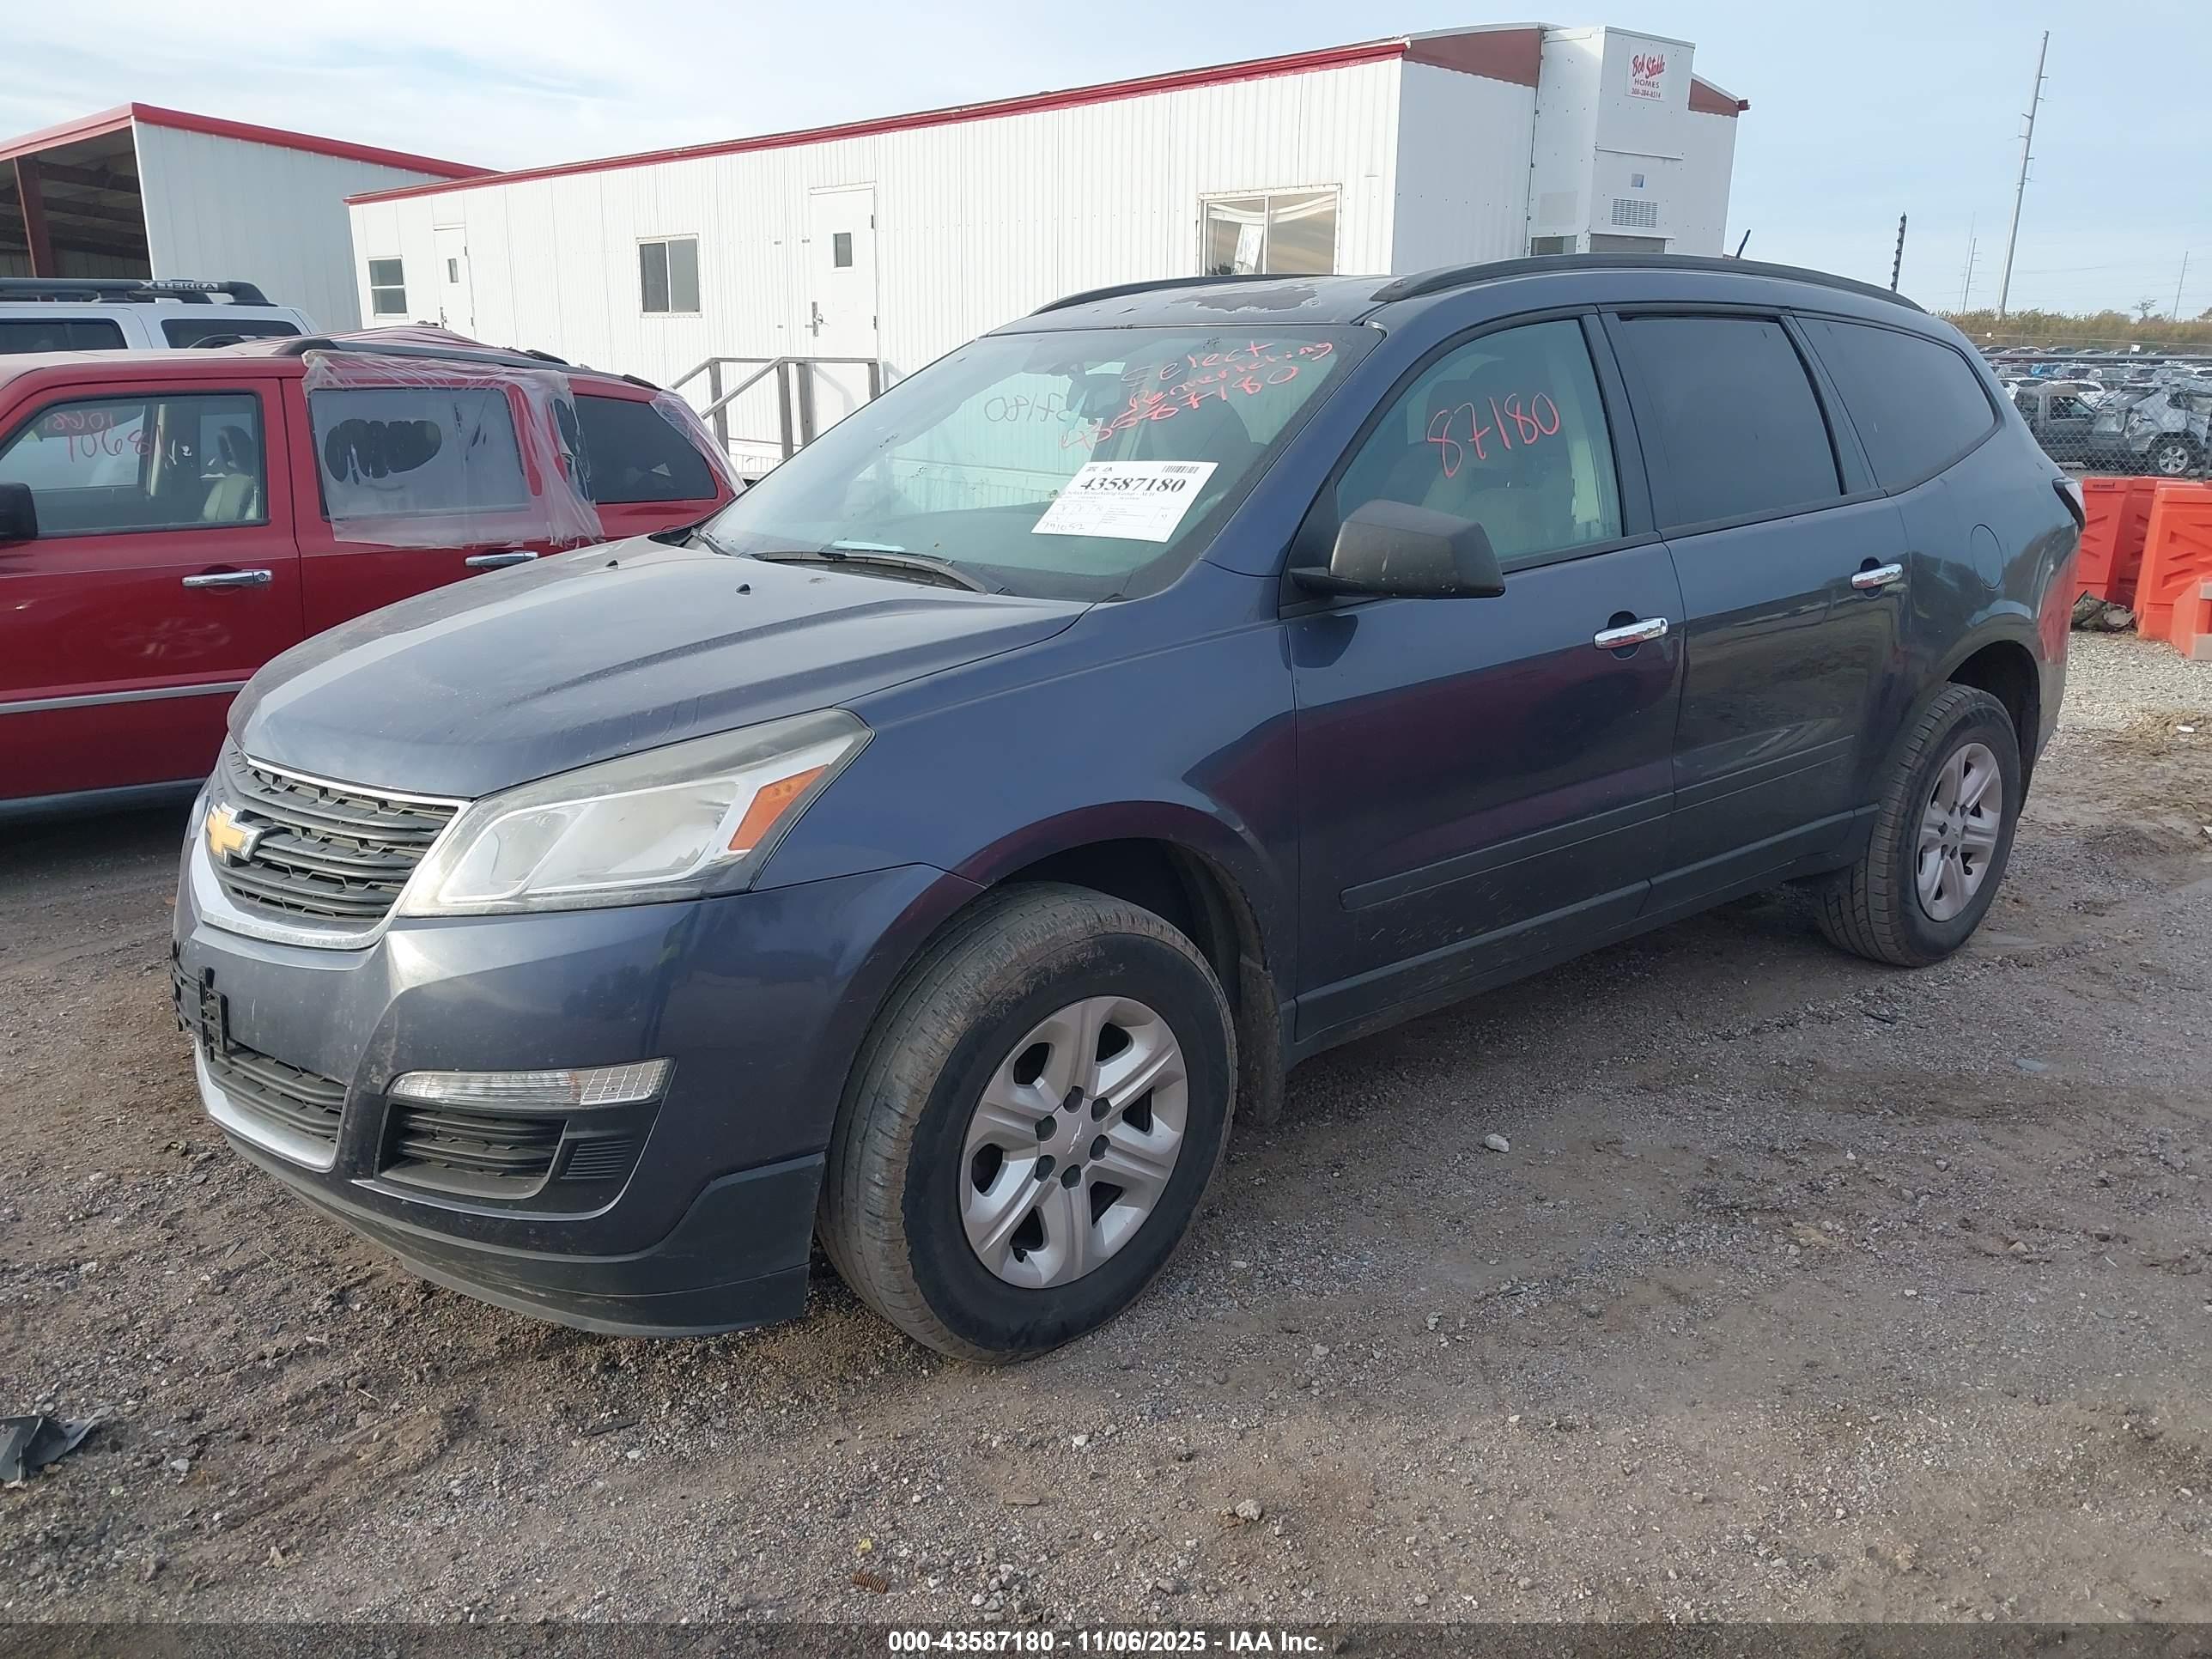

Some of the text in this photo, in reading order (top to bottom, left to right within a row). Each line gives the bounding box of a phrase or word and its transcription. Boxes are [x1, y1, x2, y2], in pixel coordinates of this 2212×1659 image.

[1634, 78, 1660, 89] HOMES
[1121, 340, 1275, 388] Select
[1426, 392, 1560, 479] 87180
[1080, 477, 1187, 493] 43587180
